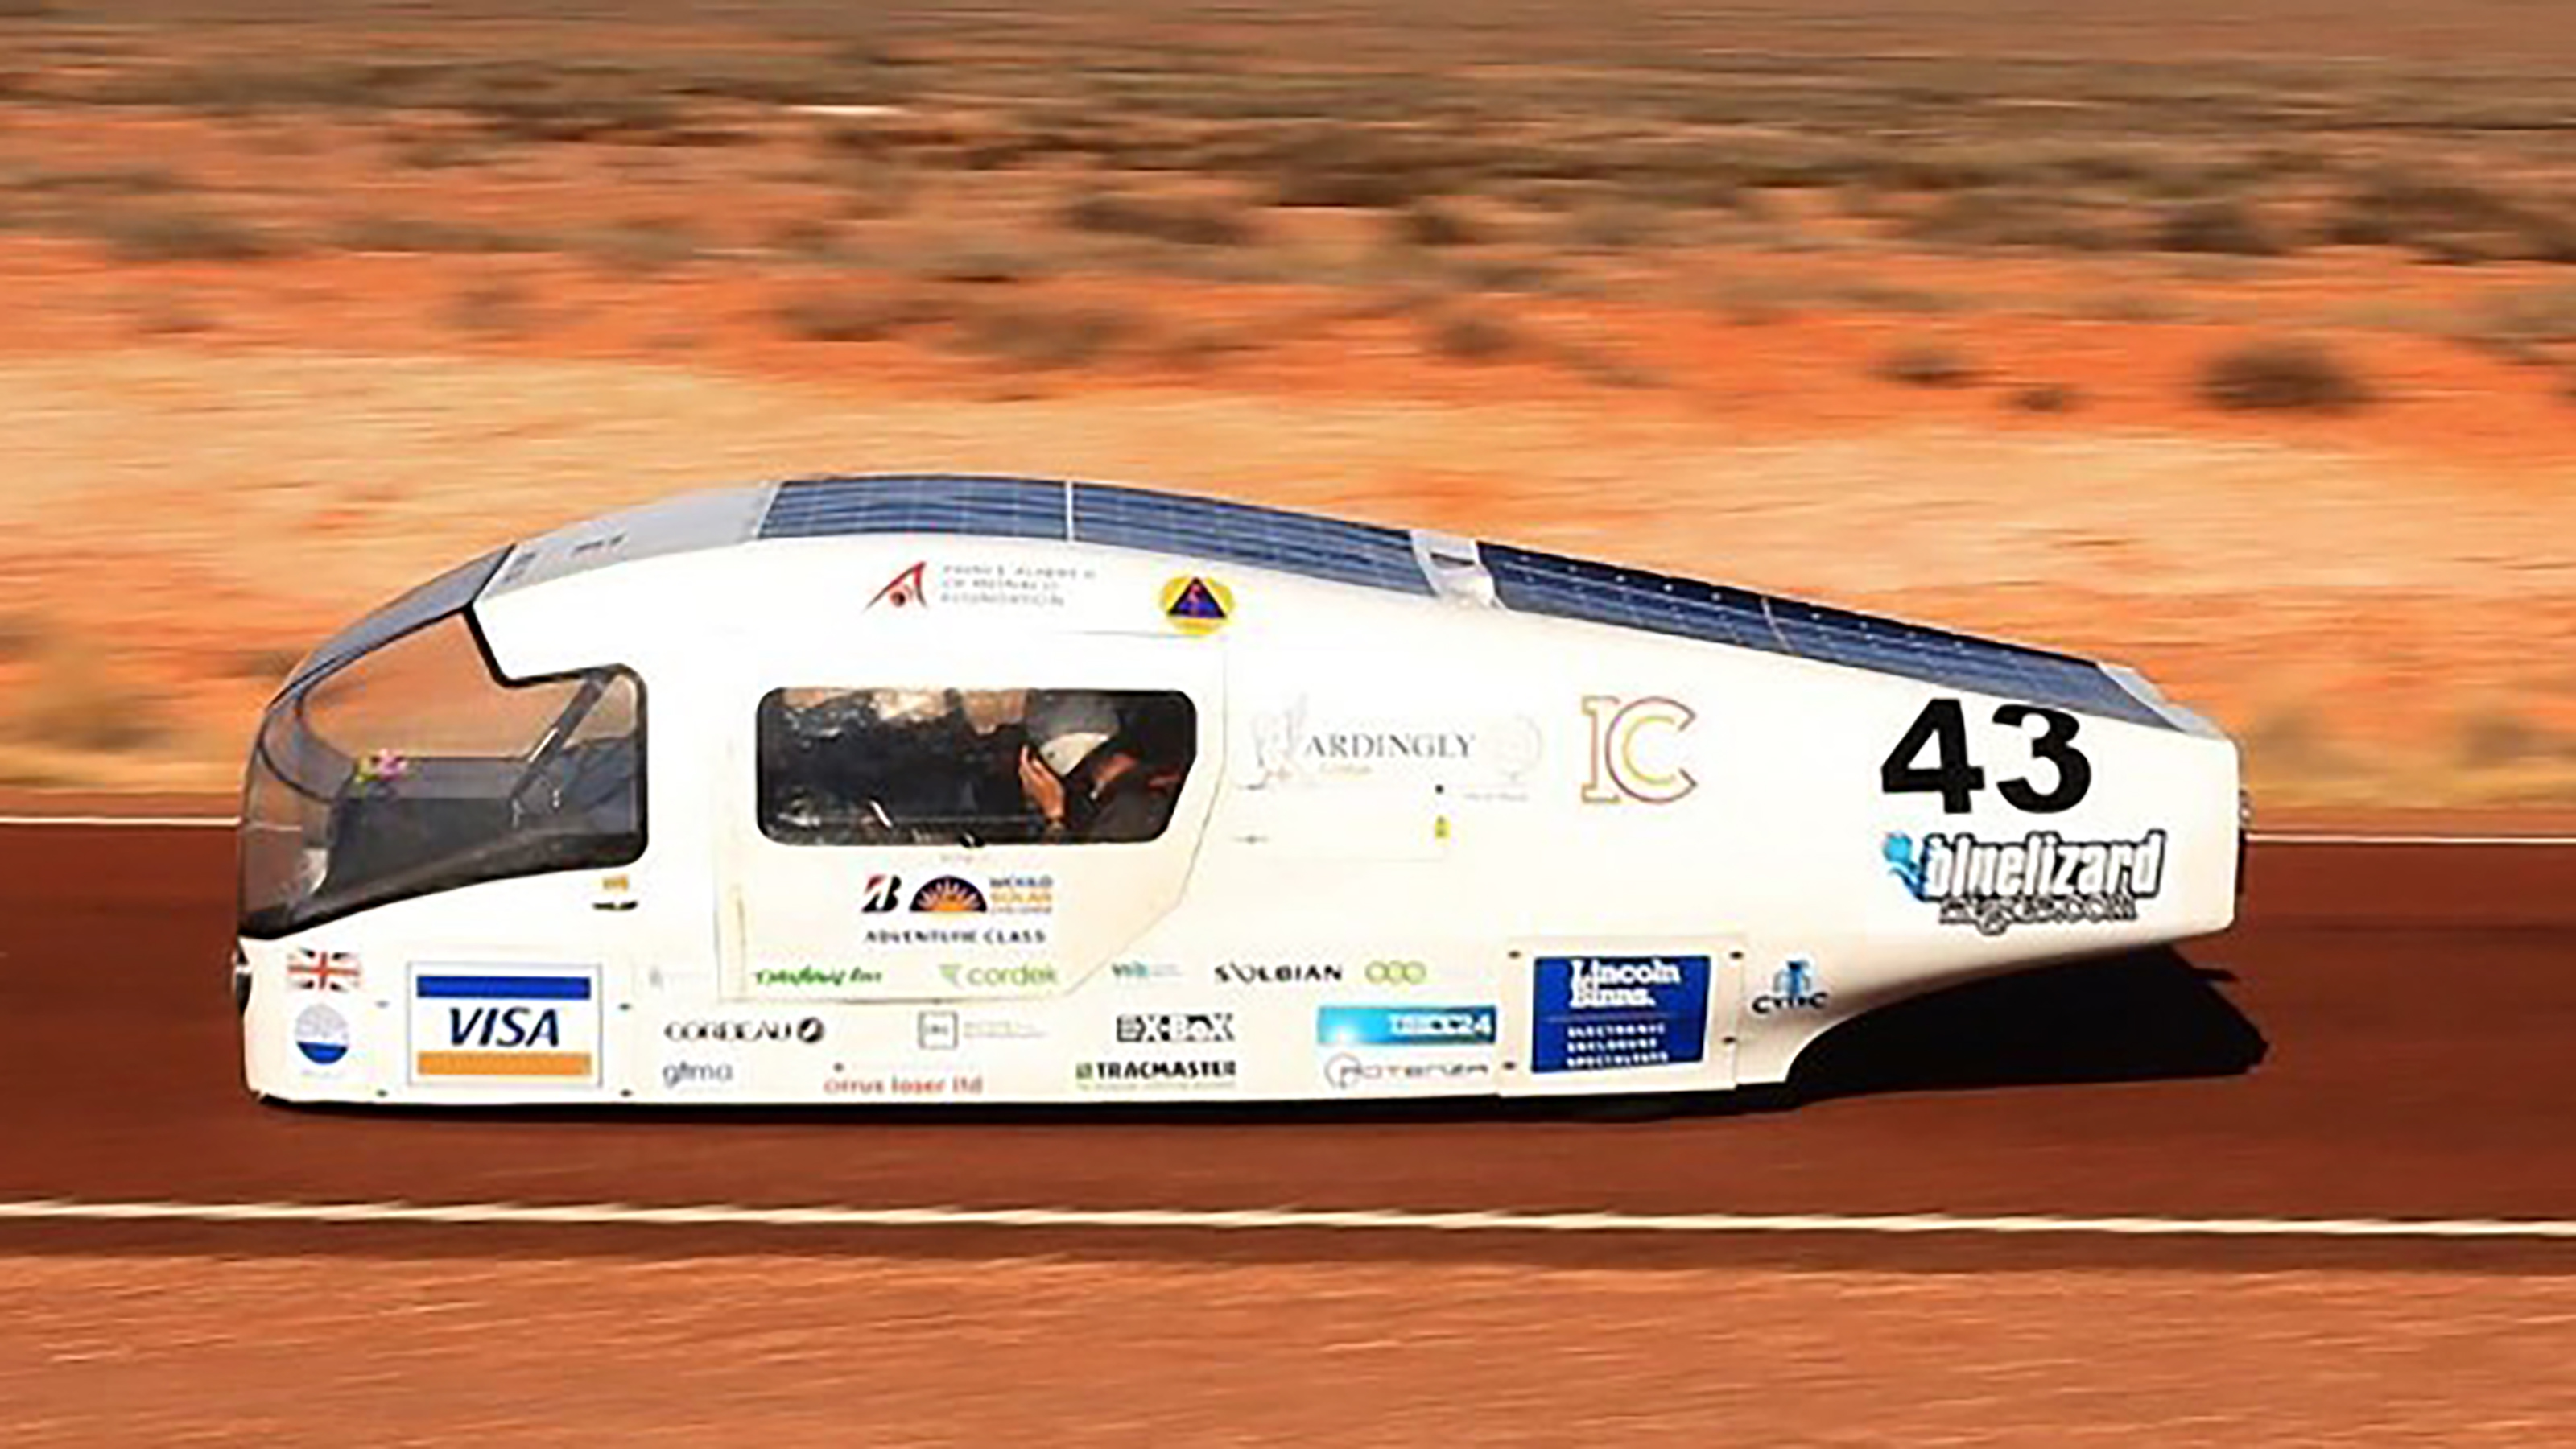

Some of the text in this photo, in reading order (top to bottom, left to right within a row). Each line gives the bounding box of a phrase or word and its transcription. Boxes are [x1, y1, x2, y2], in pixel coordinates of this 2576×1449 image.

[1303, 733, 1476, 758] ARDINGLY
[1880, 698, 2091, 814] 43
[1921, 828, 2166, 901] bluelizard
[863, 929, 976, 943] ADVENTURE
[982, 929, 1046, 943] CLASS
[966, 964, 1060, 987] cordek
[1569, 959, 1682, 985] Lincoln
[449, 1005, 560, 1047] VISA
[1096, 1059, 1236, 1080] TRACMASTER
